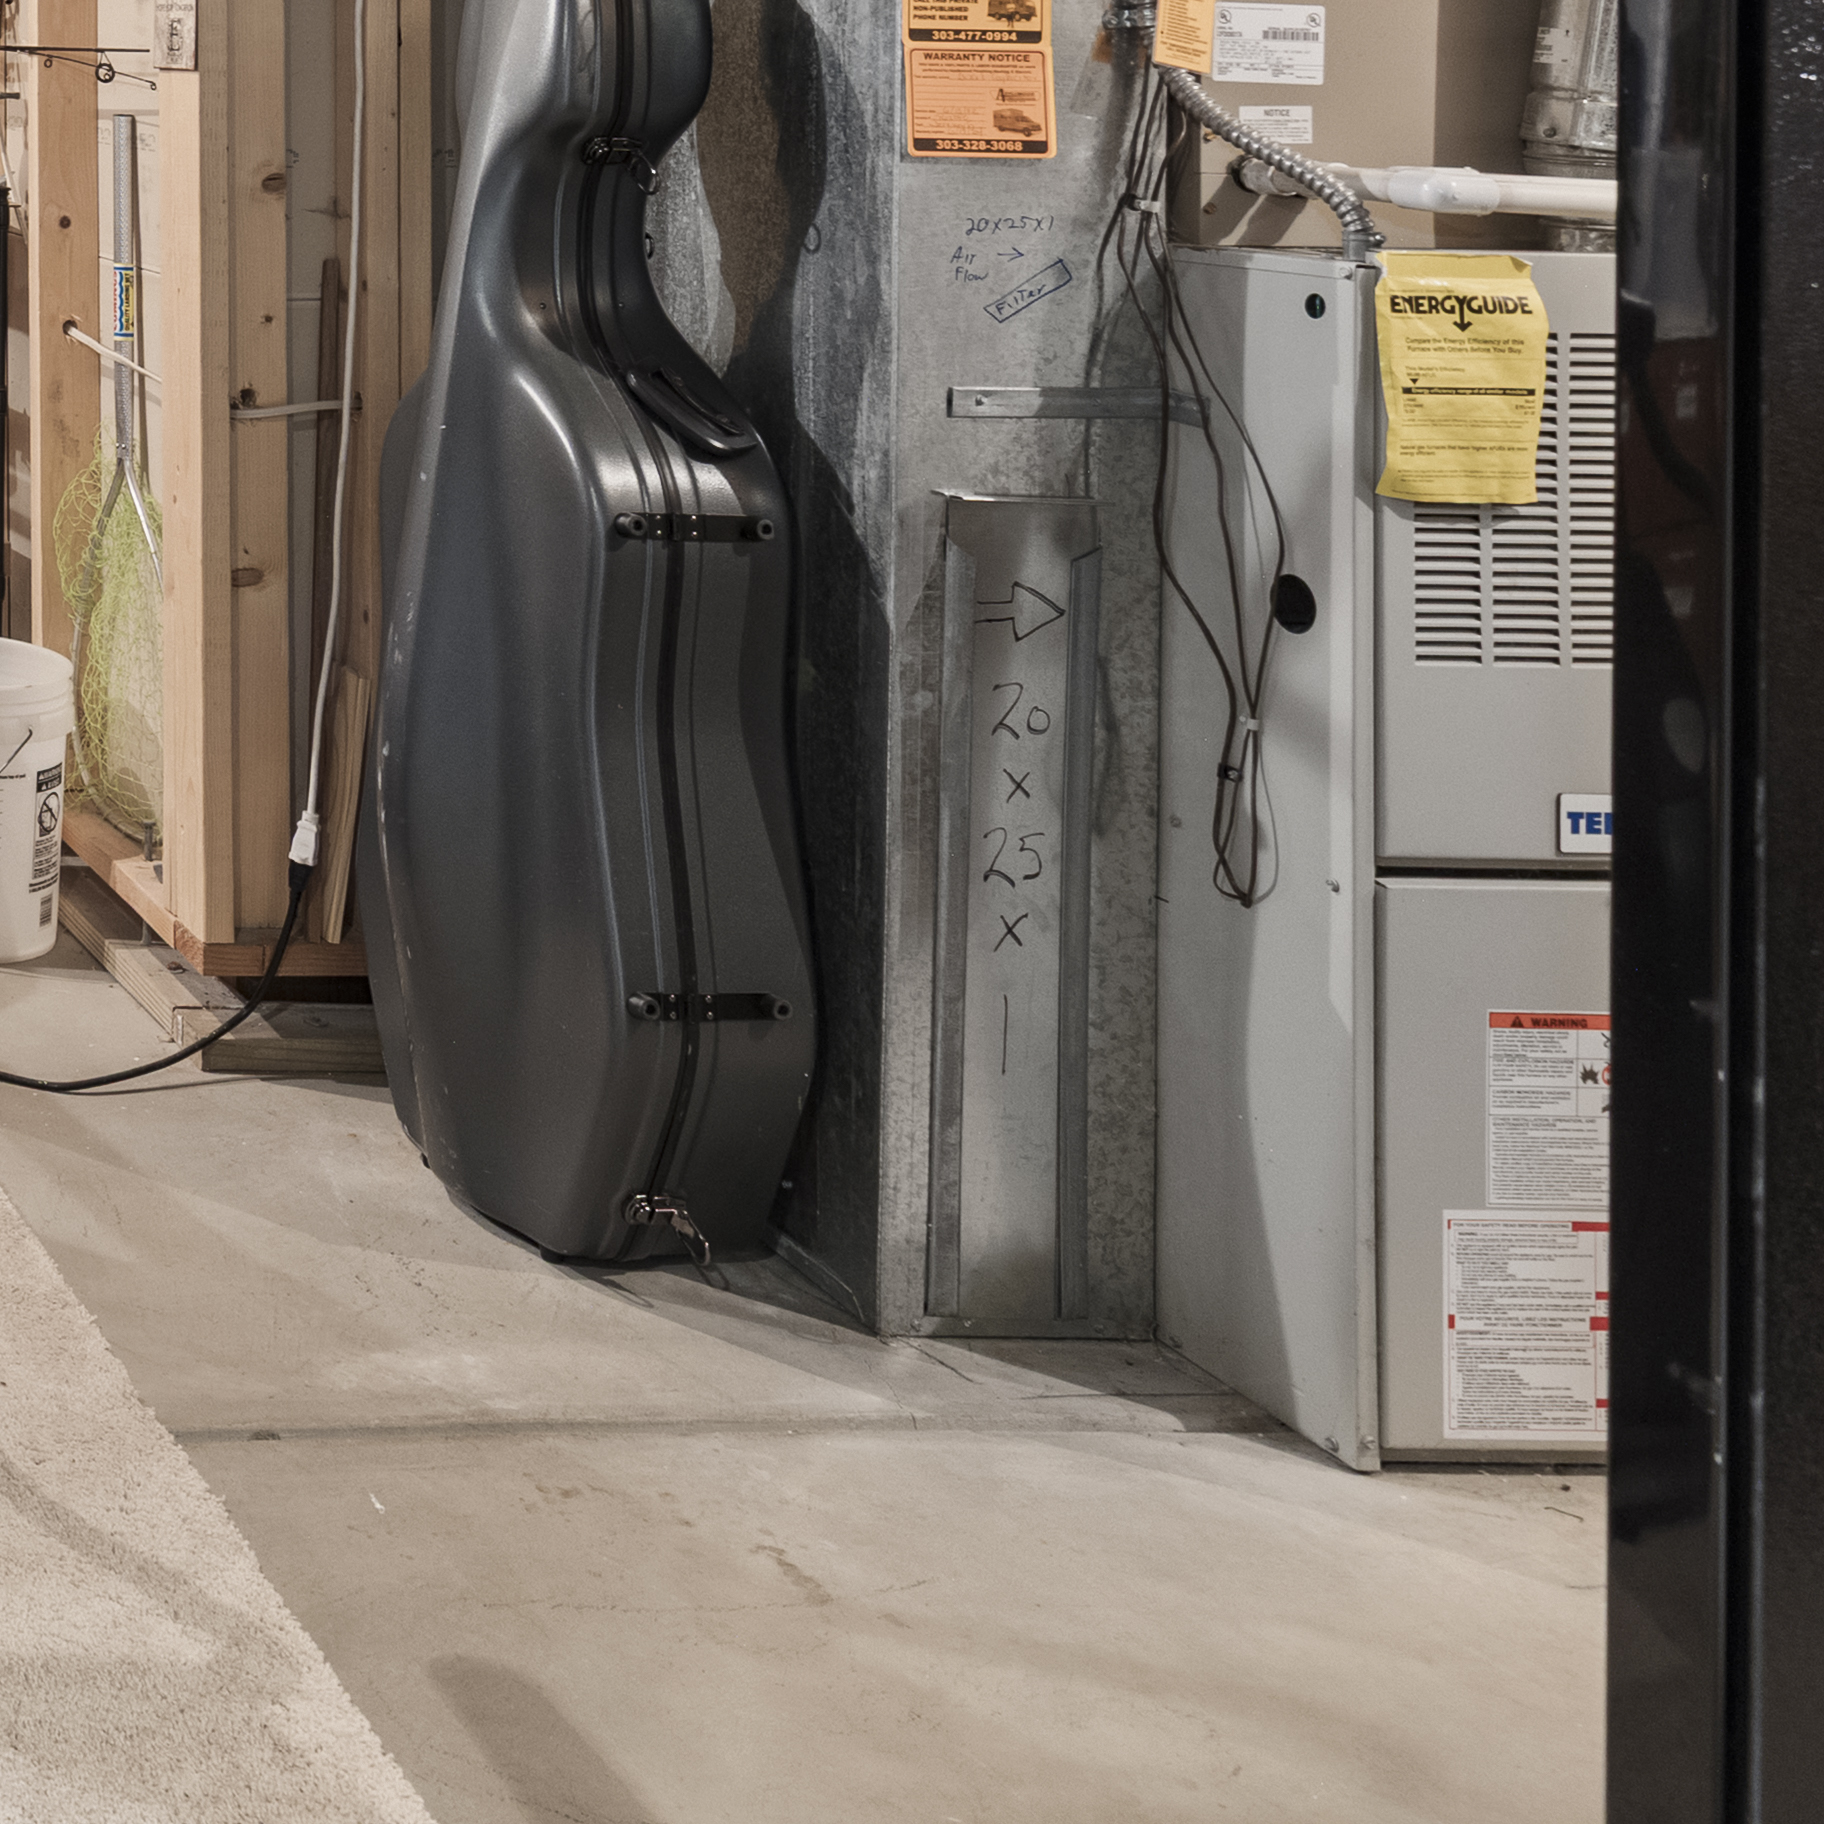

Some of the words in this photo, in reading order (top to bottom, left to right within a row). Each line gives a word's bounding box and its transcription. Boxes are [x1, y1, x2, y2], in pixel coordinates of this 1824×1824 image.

[932, 30, 1018, 43] 303-477-0994
[922, 51, 985, 62] WARRANTY
[987, 52, 1031, 63] NOTICE
[935, 139, 1024, 152] 303-328-3068
[1390, 295, 1534, 318] ENERGYGUIDE
[1443, 337, 1467, 347] Energy
[1467, 338, 1501, 348] Efficiency
[1511, 338, 1525, 347] this
[1492, 346, 1507, 354] You
[990, 681, 1053, 739] 20
[1566, 811, 1613, 836] TE
[982, 826, 1044, 888] 25
[1529, 1016, 1589, 1029] WARNING
